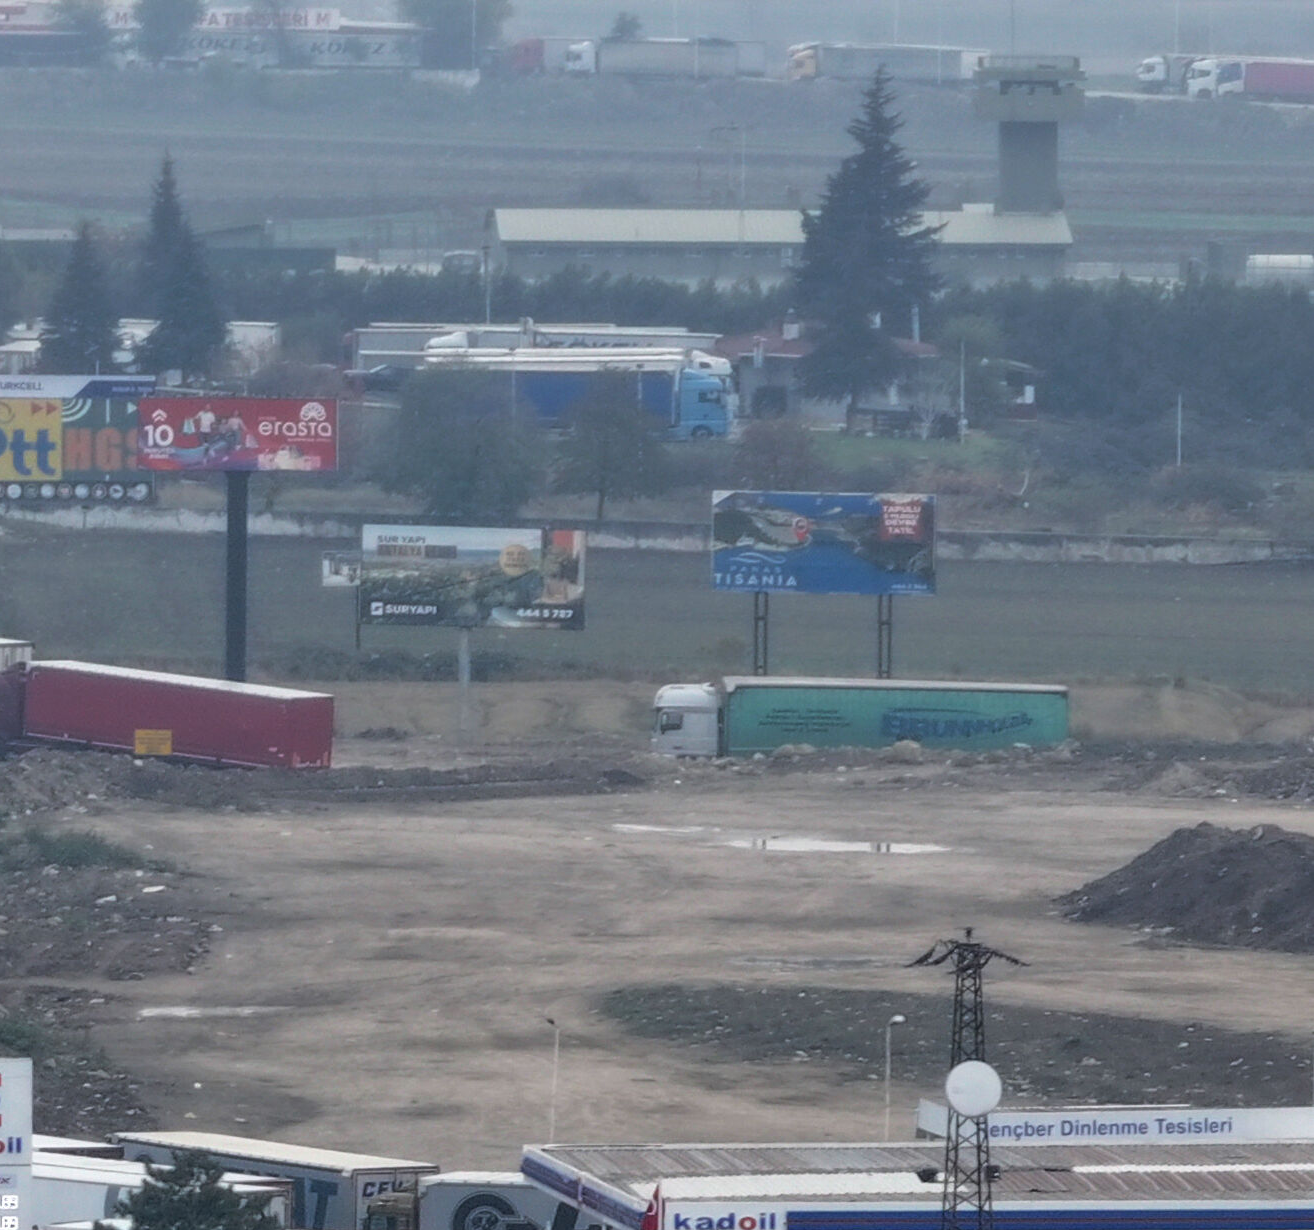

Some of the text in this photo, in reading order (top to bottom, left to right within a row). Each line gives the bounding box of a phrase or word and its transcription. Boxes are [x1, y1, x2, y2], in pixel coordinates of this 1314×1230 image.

[144, 425, 174, 447] 10
[385, 604, 438, 616] SURYAPI
[1061, 1119, 1149, 1137] Dinlenme
[1155, 1117, 1233, 1135] Tesisleri
[674, 1212, 776, 1230] kadoil
